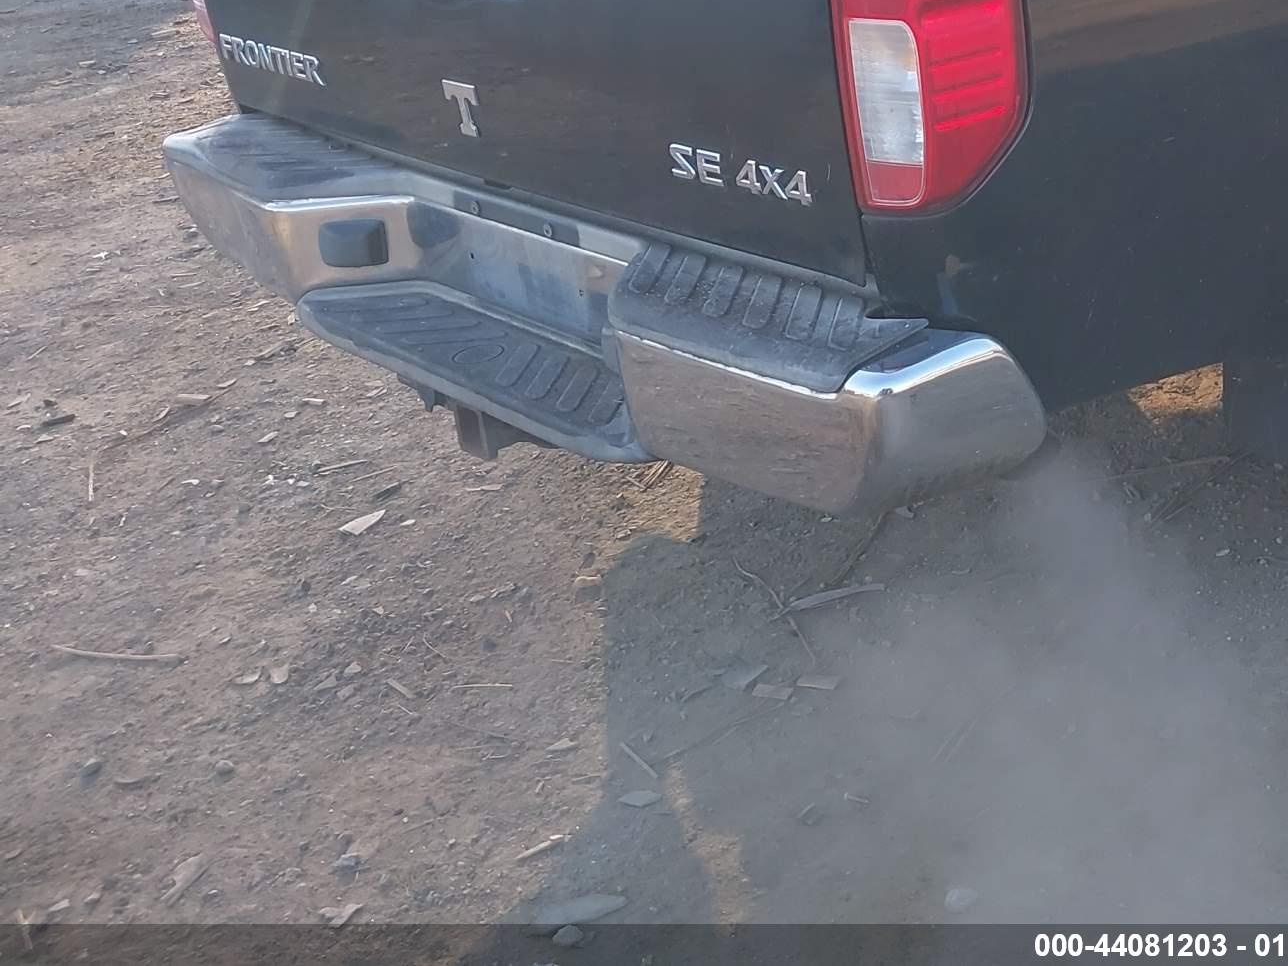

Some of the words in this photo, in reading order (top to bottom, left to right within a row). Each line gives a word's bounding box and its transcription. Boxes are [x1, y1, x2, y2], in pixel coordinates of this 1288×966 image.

[219, 33, 327, 87] FRONTIER
[441, 78, 481, 138] T
[668, 142, 725, 187] SE
